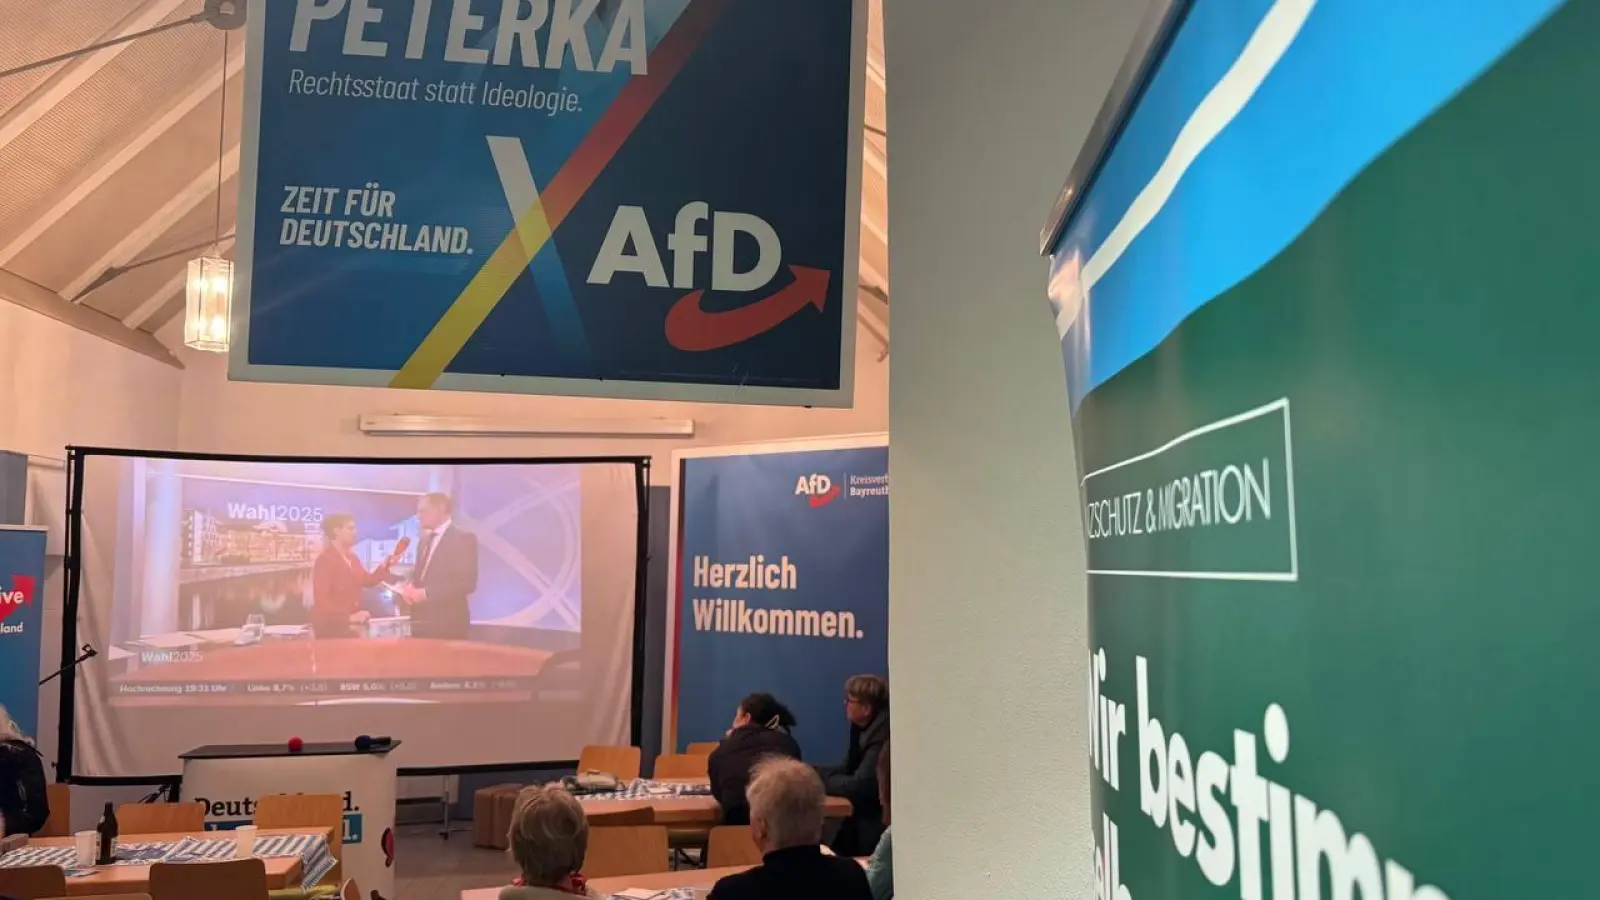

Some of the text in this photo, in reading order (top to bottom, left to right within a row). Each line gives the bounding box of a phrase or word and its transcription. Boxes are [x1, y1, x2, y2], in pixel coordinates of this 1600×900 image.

[289, 69, 583, 116] Rechtsstaat statt Ideologie.
[280, 182, 396, 217] ZEIT FÜR
[280, 218, 474, 255] DEUTSCHLAND.
[586, 201, 782, 292] AfD
[795, 473, 831, 495] AfD
[1087, 457, 1271, 539] ZSCHUTZ & MIGRATION
[227, 502, 323, 522] Wahl2025
[694, 555, 797, 589] Herzlich
[692, 598, 864, 639] Willkommen.
[141, 651, 203, 664] Wahl2025
[1136, 655, 1453, 900] bestim
